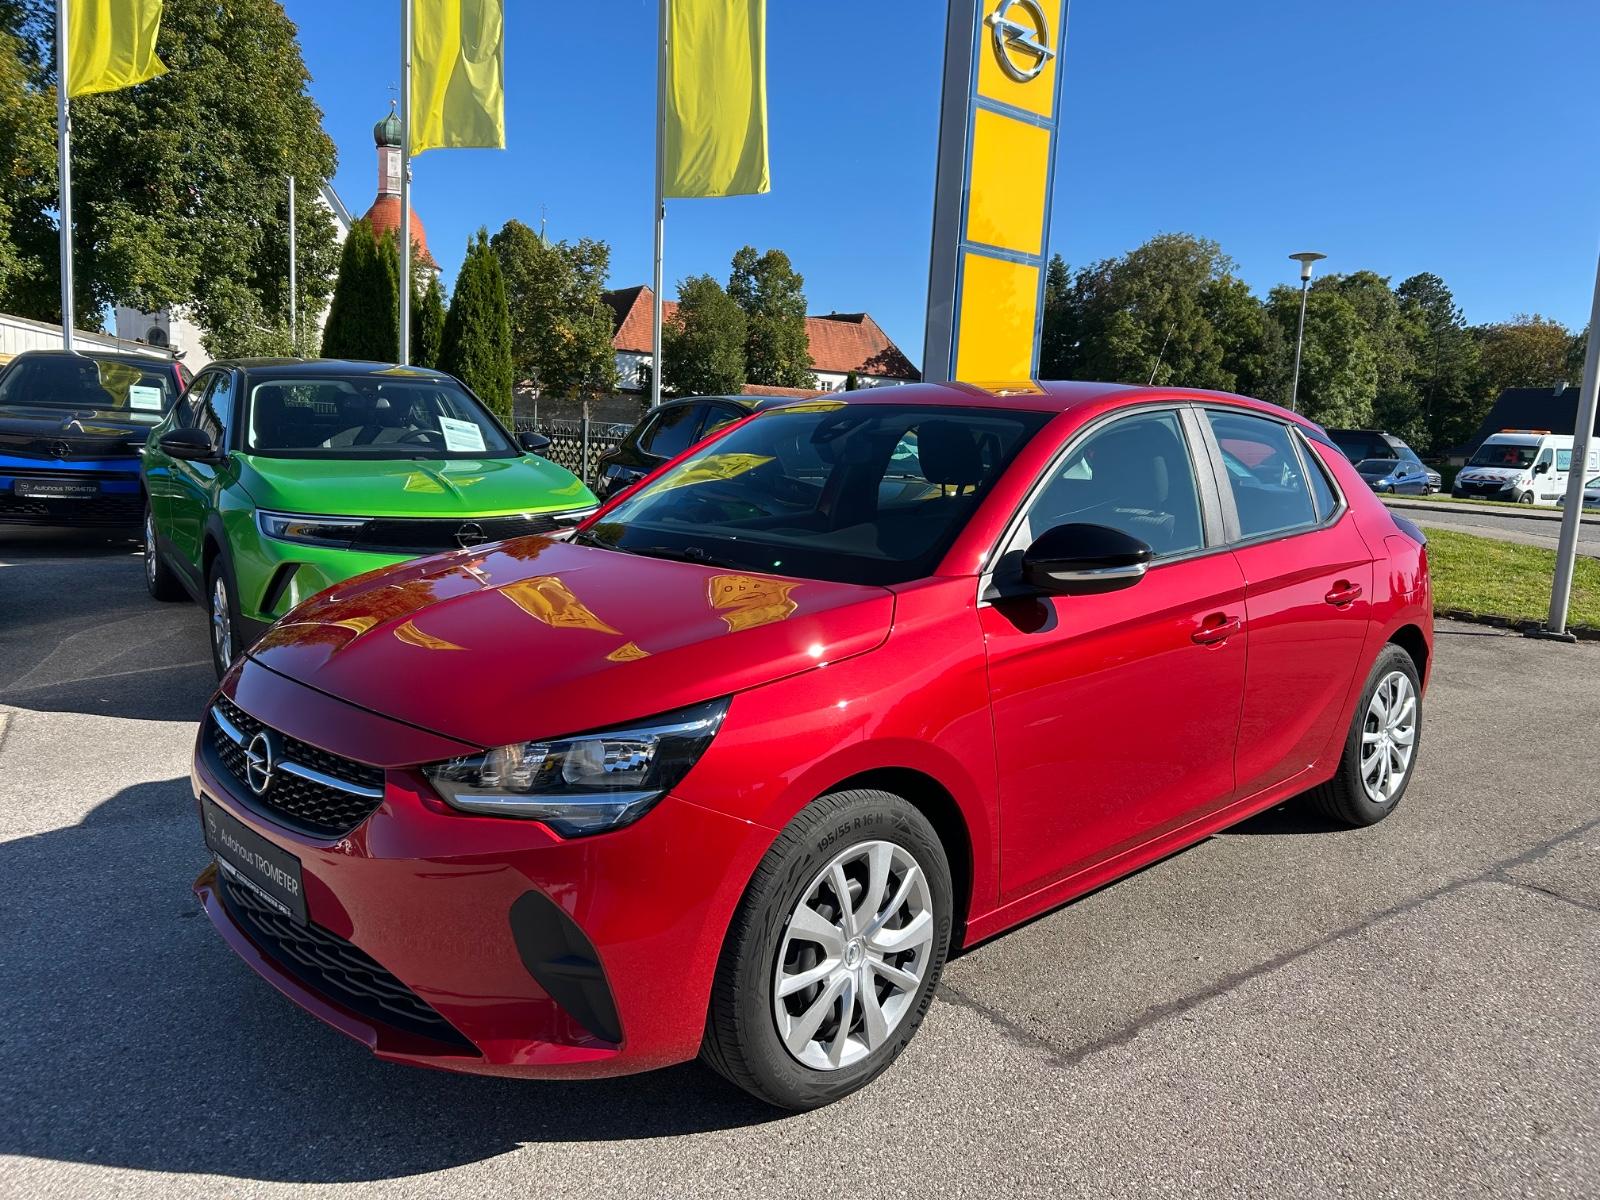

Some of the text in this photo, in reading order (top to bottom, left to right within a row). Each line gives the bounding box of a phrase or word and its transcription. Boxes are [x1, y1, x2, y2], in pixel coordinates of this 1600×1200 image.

[817, 812, 883, 853] 195/55 R 16 H
[220, 828, 254, 865] Autohaus
[254, 852, 298, 896] TROMETER
